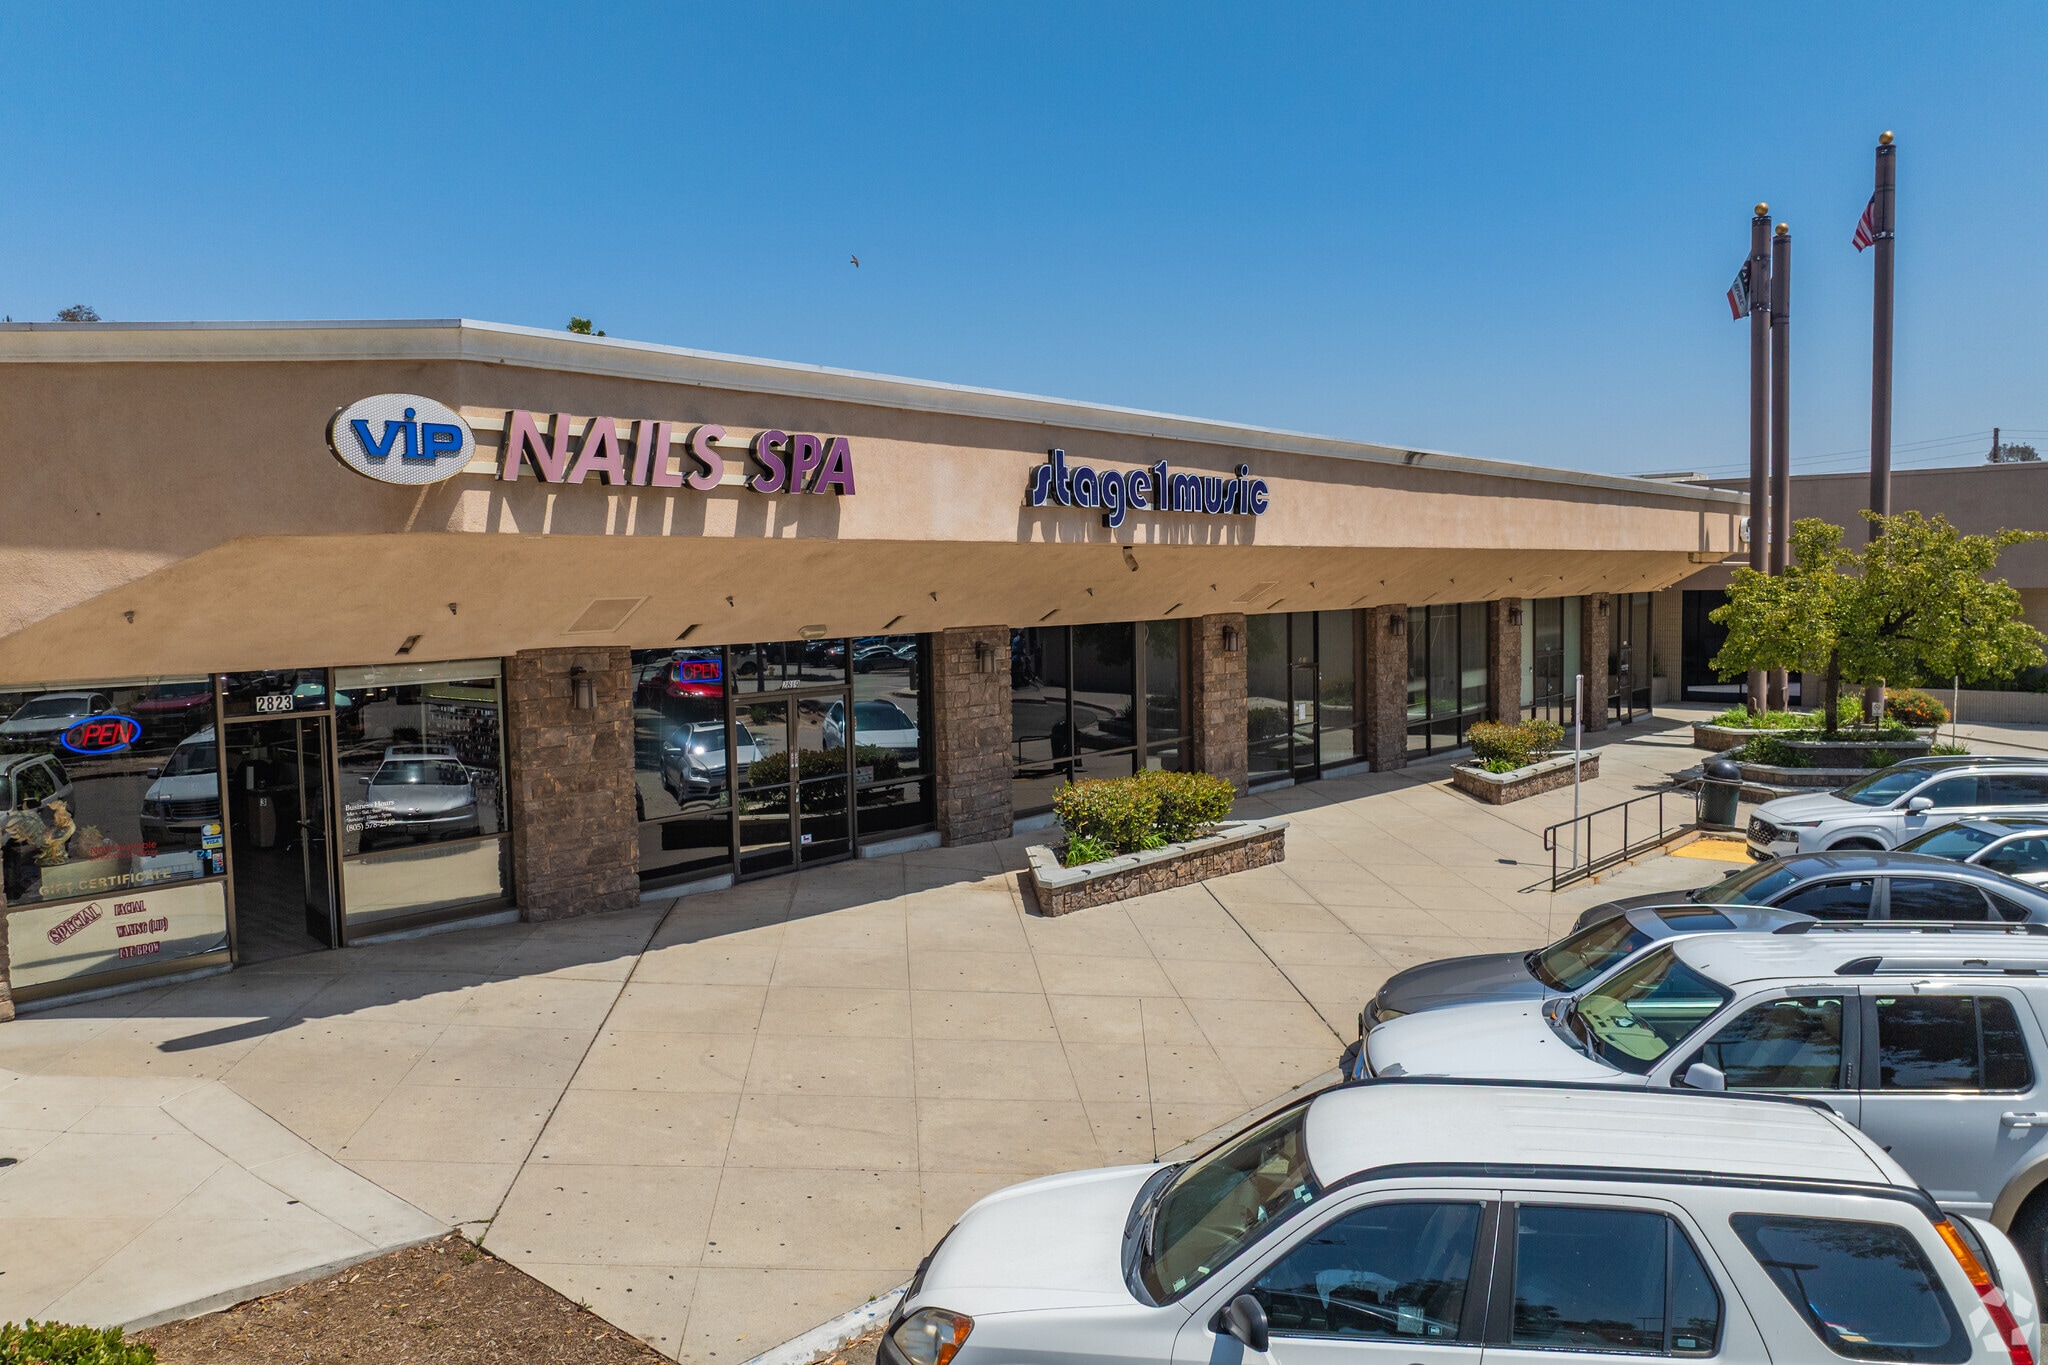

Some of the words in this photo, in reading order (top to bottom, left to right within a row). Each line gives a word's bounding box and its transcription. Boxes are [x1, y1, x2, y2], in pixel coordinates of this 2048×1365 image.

[500, 409, 727, 492] NAILS
[747, 428, 857, 496] SPA
[683, 662, 719, 680] OPEN
[781, 679, 801, 690] 2819
[257, 695, 292, 711] 2823
[65, 722, 133, 748] OPEN
[346, 823, 364, 832] (805)
[89, 846, 112, 855] Now
[115, 841, 157, 850] Available
[38, 880, 73, 897] GIFT
[78, 867, 172, 890] CERTIFICATE
[114, 899, 146, 916] FACIAL
[49, 905, 101, 943] SPECIAL
[149, 917, 168, 934] (LIP)
[118, 945, 136, 960] EYE
[136, 941, 161, 957] BROW
